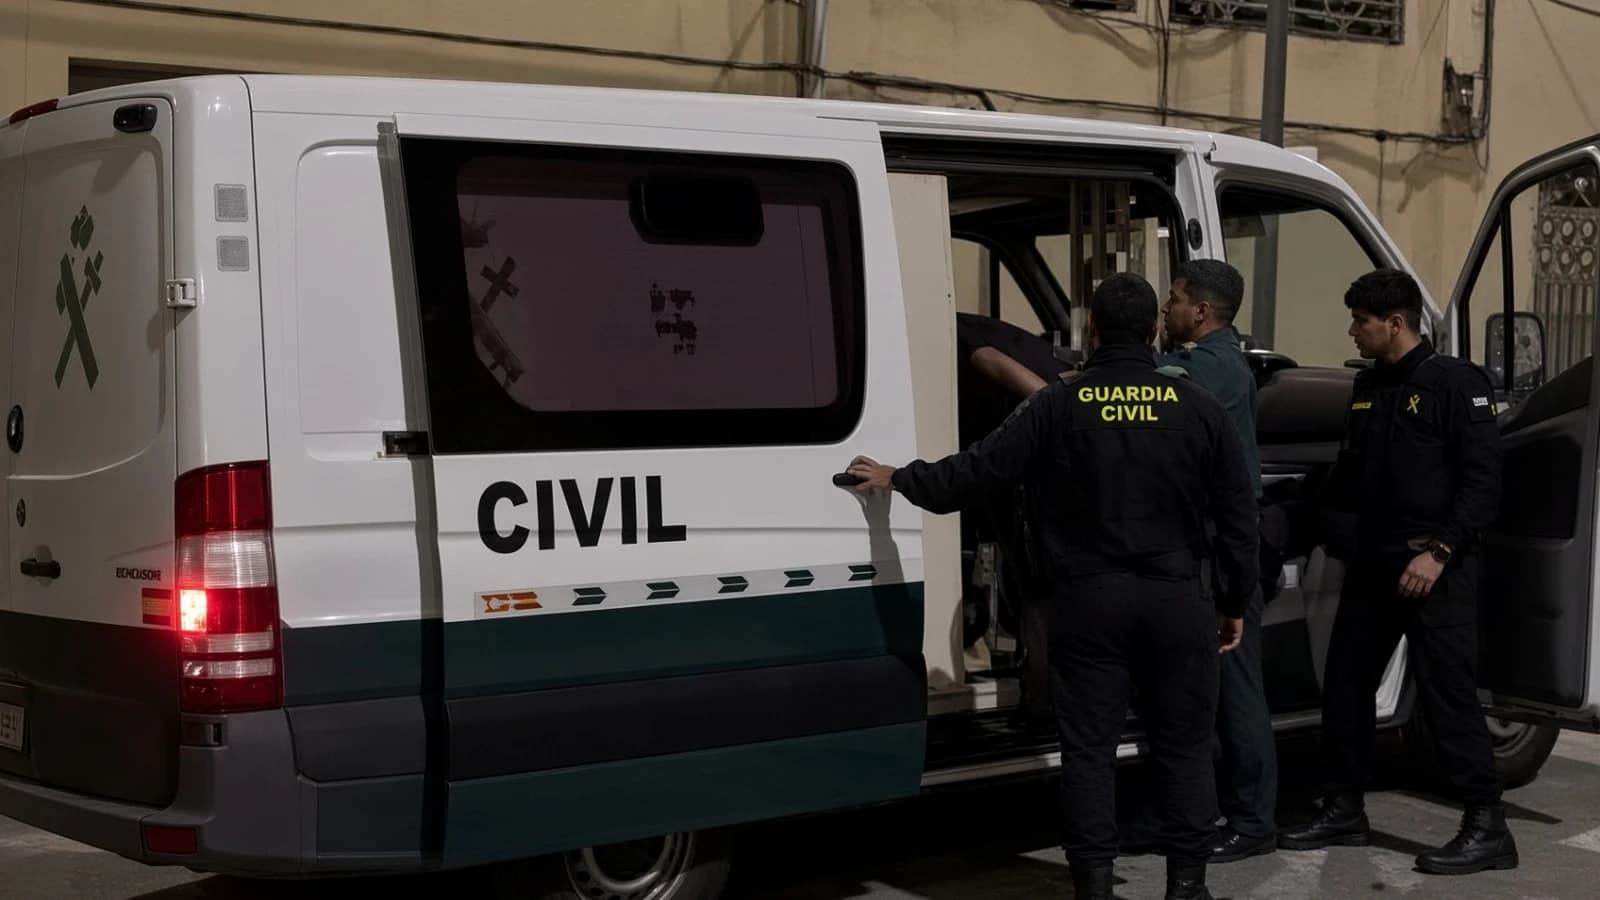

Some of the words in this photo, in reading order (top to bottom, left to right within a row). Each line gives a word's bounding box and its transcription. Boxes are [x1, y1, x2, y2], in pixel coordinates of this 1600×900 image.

[1078, 386, 1179, 402] GUARDIA
[1101, 405, 1159, 421] CIVIL
[477, 475, 687, 554] CIVIL
